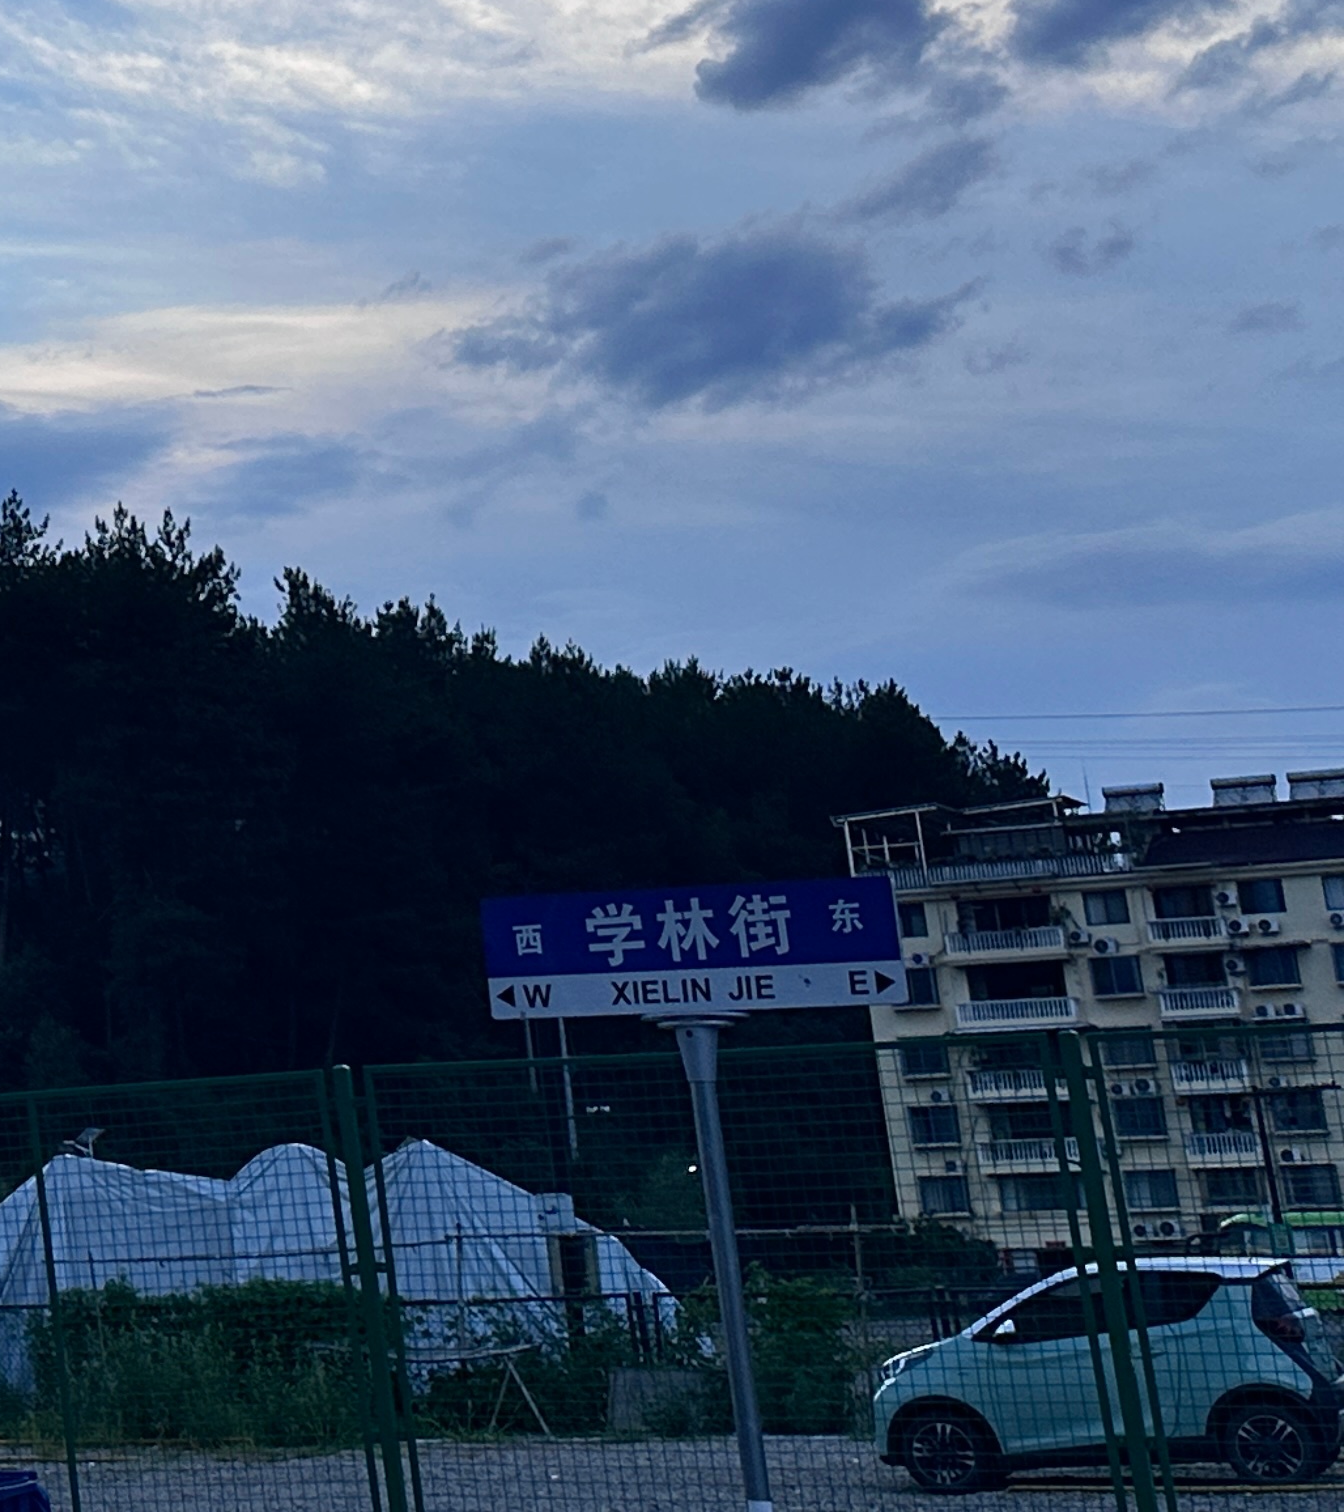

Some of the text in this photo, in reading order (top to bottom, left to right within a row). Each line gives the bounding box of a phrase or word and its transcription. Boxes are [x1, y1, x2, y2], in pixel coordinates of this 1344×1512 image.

[513, 894, 864, 966] 西 学林街 东
[523, 970, 869, 1008] W XIELIN JIE E
